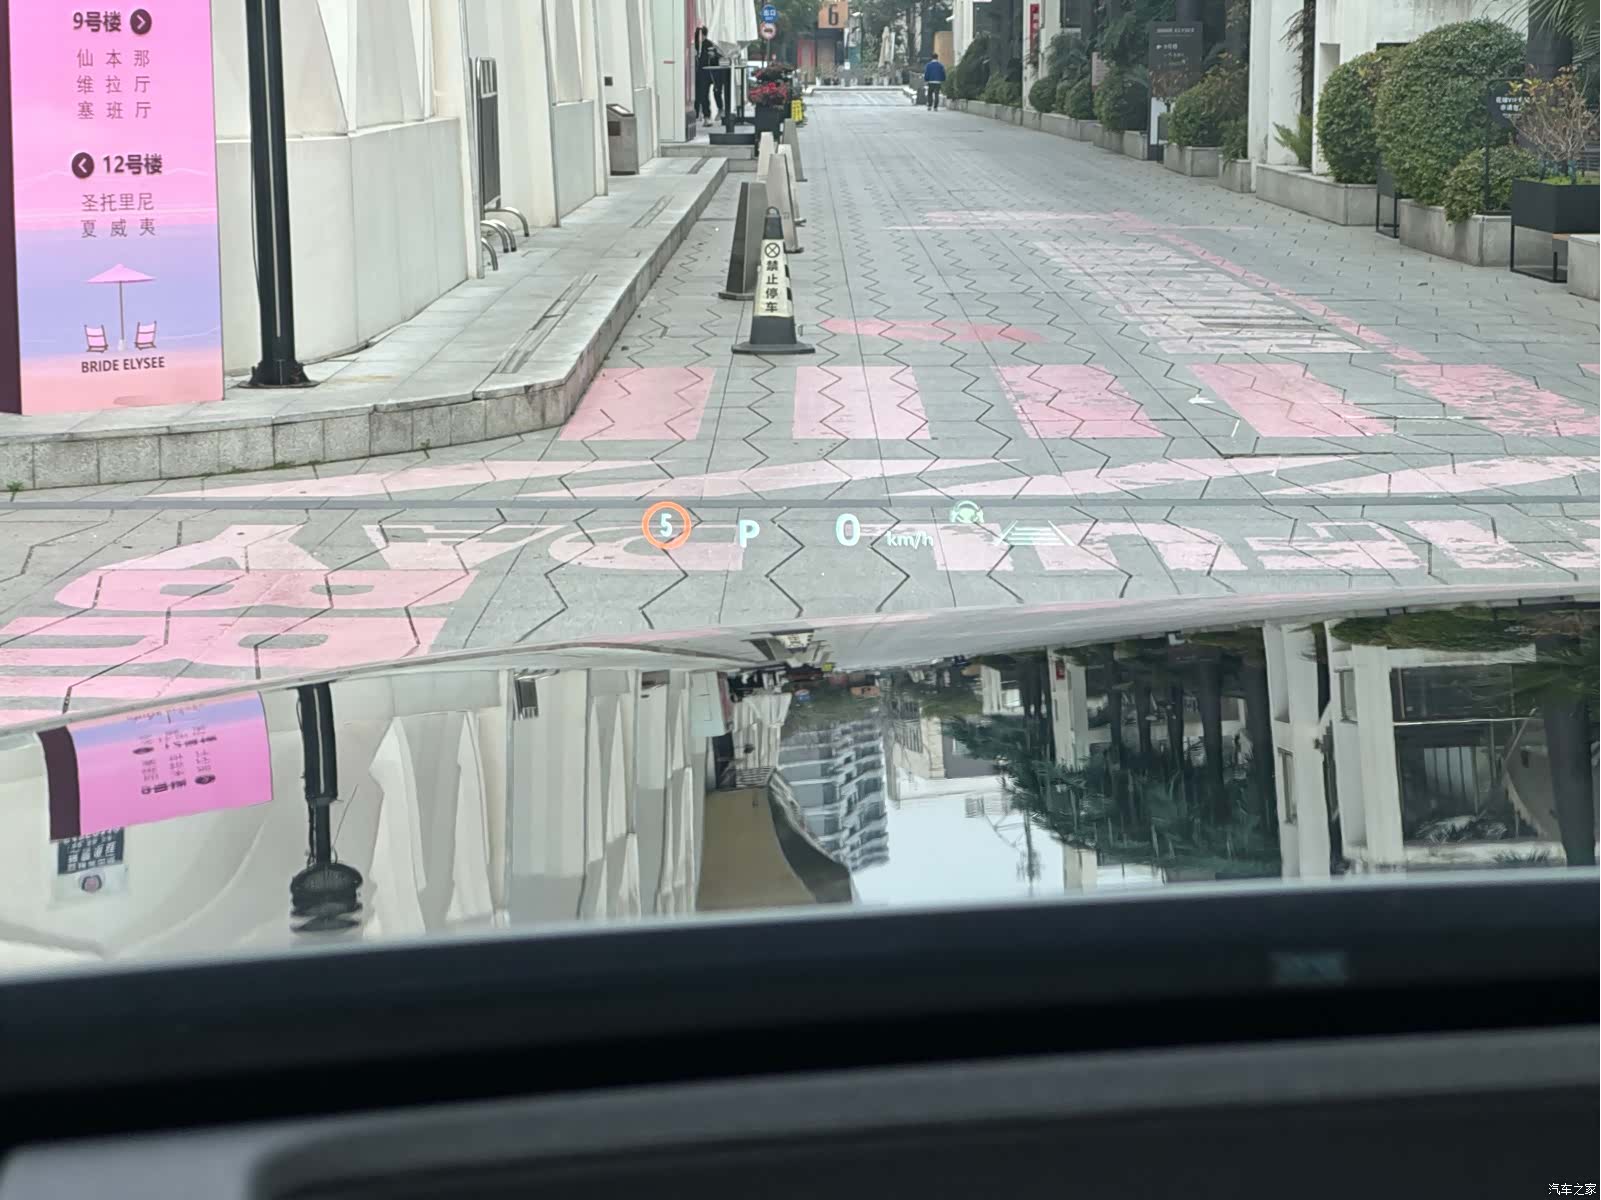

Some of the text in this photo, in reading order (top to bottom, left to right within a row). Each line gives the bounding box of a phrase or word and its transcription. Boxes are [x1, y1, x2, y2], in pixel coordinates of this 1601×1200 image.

[73, 11, 122, 32] 9号楼
[828, 4, 839, 26] 6
[77, 49, 150, 68] 仙本那
[77, 75, 151, 94] 维拉厅
[78, 101, 152, 120] 塞班厅
[103, 153, 163, 175] 12号楼
[82, 193, 154, 212] 圣托里尼
[81, 218, 156, 238] 夏威夷
[764, 260, 779, 313] 禁止停车
[81, 356, 165, 373] BRIDE ELYSEE
[660, 513, 673, 537] 5
[739, 519, 760, 548] P
[835, 513, 934, 550] 0 km/h
